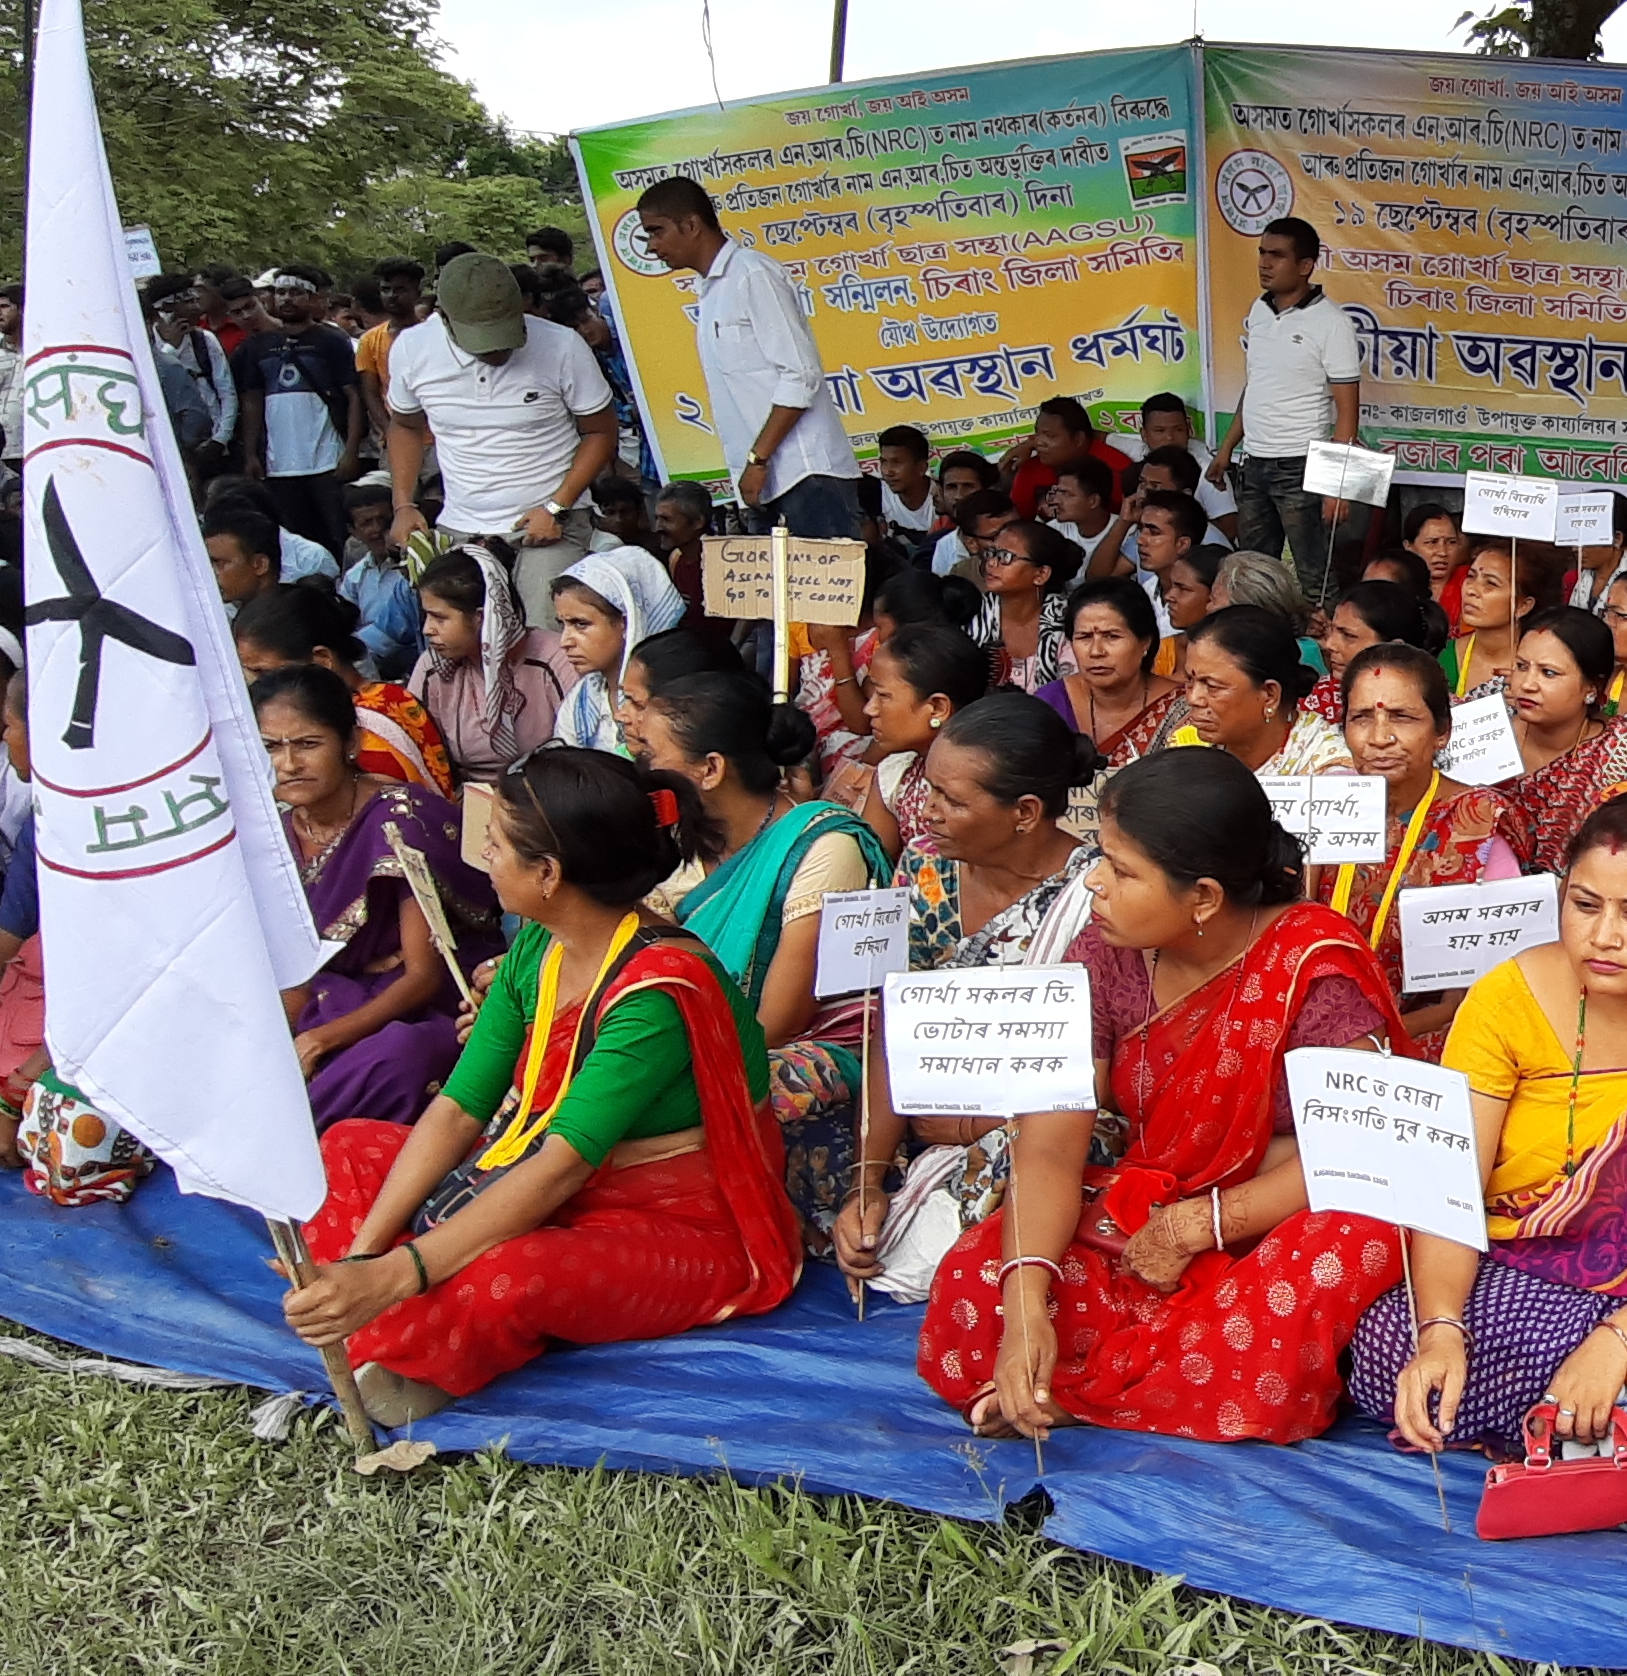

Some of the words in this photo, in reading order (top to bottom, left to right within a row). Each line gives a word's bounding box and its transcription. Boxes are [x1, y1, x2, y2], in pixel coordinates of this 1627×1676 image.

[785, 110, 810, 126] জয়
[865, 97, 893, 115] জয়
[896, 90, 929, 110] আই
[931, 86, 970, 105] অসম
[1429, 76, 1455, 95] জয়
[1516, 81, 1541, 100] জয়
[1549, 80, 1579, 105] আই
[1583, 86, 1622, 105] অসম
[614, 165, 669, 190] অসমত
[929, 126, 944, 146] ত
[949, 120, 979, 145] নাম
[1111, 94, 1171, 125] বিৰুদ্ধে
[1232, 103, 1292, 131] অসমত
[1298, 99, 1405, 139] গোৰ্খাসকলৰ
[1571, 127, 1586, 150] ত
[1591, 127, 1621, 155] নাম
[725, 183, 782, 212] প্ৰতিজন
[786, 169, 842, 204] গোৰ্খাৰ
[844, 170, 874, 193] নাম
[1061, 136, 1109, 168] দাবীত
[1301, 152, 1340, 180] আৰু
[1345, 148, 1404, 185] প্ৰতিজন
[1411, 153, 1468, 191] গোৰ্খাৰ
[1474, 161, 1503, 191] নাম
[1024, 180, 1074, 213] দিনা
[1333, 200, 1367, 227] ১৯
[814, 242, 893, 275] গোৰ্খা
[897, 241, 948, 265] ছাত্ৰ
[921, 266, 1000, 301] চিৰাং
[1002, 257, 1079, 291] জিলা
[1086, 236, 1185, 274] সমিতিৰ
[1342, 250, 1413, 276] অসম
[1421, 252, 1509, 282] গোৰ্খা
[1510, 259, 1561, 287] ছাত্ৰ
[1386, 280, 1458, 313] চিৰাং
[1465, 285, 1534, 319] জিলা
[880, 316, 917, 348] যৌথ
[675, 392, 715, 435] ২
[1069, 305, 1186, 369] ধৰ্মঘট
[1470, 441, 1526, 475] পৰা
[818, 554, 840, 565] OF
[756, 588, 770, 598] TO
[1300, 794, 1360, 819] গোৰ্খা,
[1327, 831, 1381, 848] অসম
[835, 907, 872, 930] গোৰ্খা
[1422, 907, 1473, 925] অসম
[1476, 899, 1544, 921] সৰকাৰ
[1448, 934, 1483, 951] হায়
[1488, 928, 1522, 947] হায়
[900, 980, 961, 1005] গোৰ্খা
[966, 986, 1038, 1004] সকলৰ
[1043, 979, 1075, 1005] ডি.
[913, 1016, 992, 1040] ভোটাৰ
[997, 1021, 1069, 1040] সমস্যা
[919, 1056, 1004, 1075] সমাধান
[1009, 1056, 1069, 1074] কৰক
[1326, 1070, 1368, 1094] NRC
[1373, 1079, 1389, 1098] ত
[1302, 1098, 1388, 1131] বিসংগতি
[1392, 1117, 1421, 1144] দুৰ
